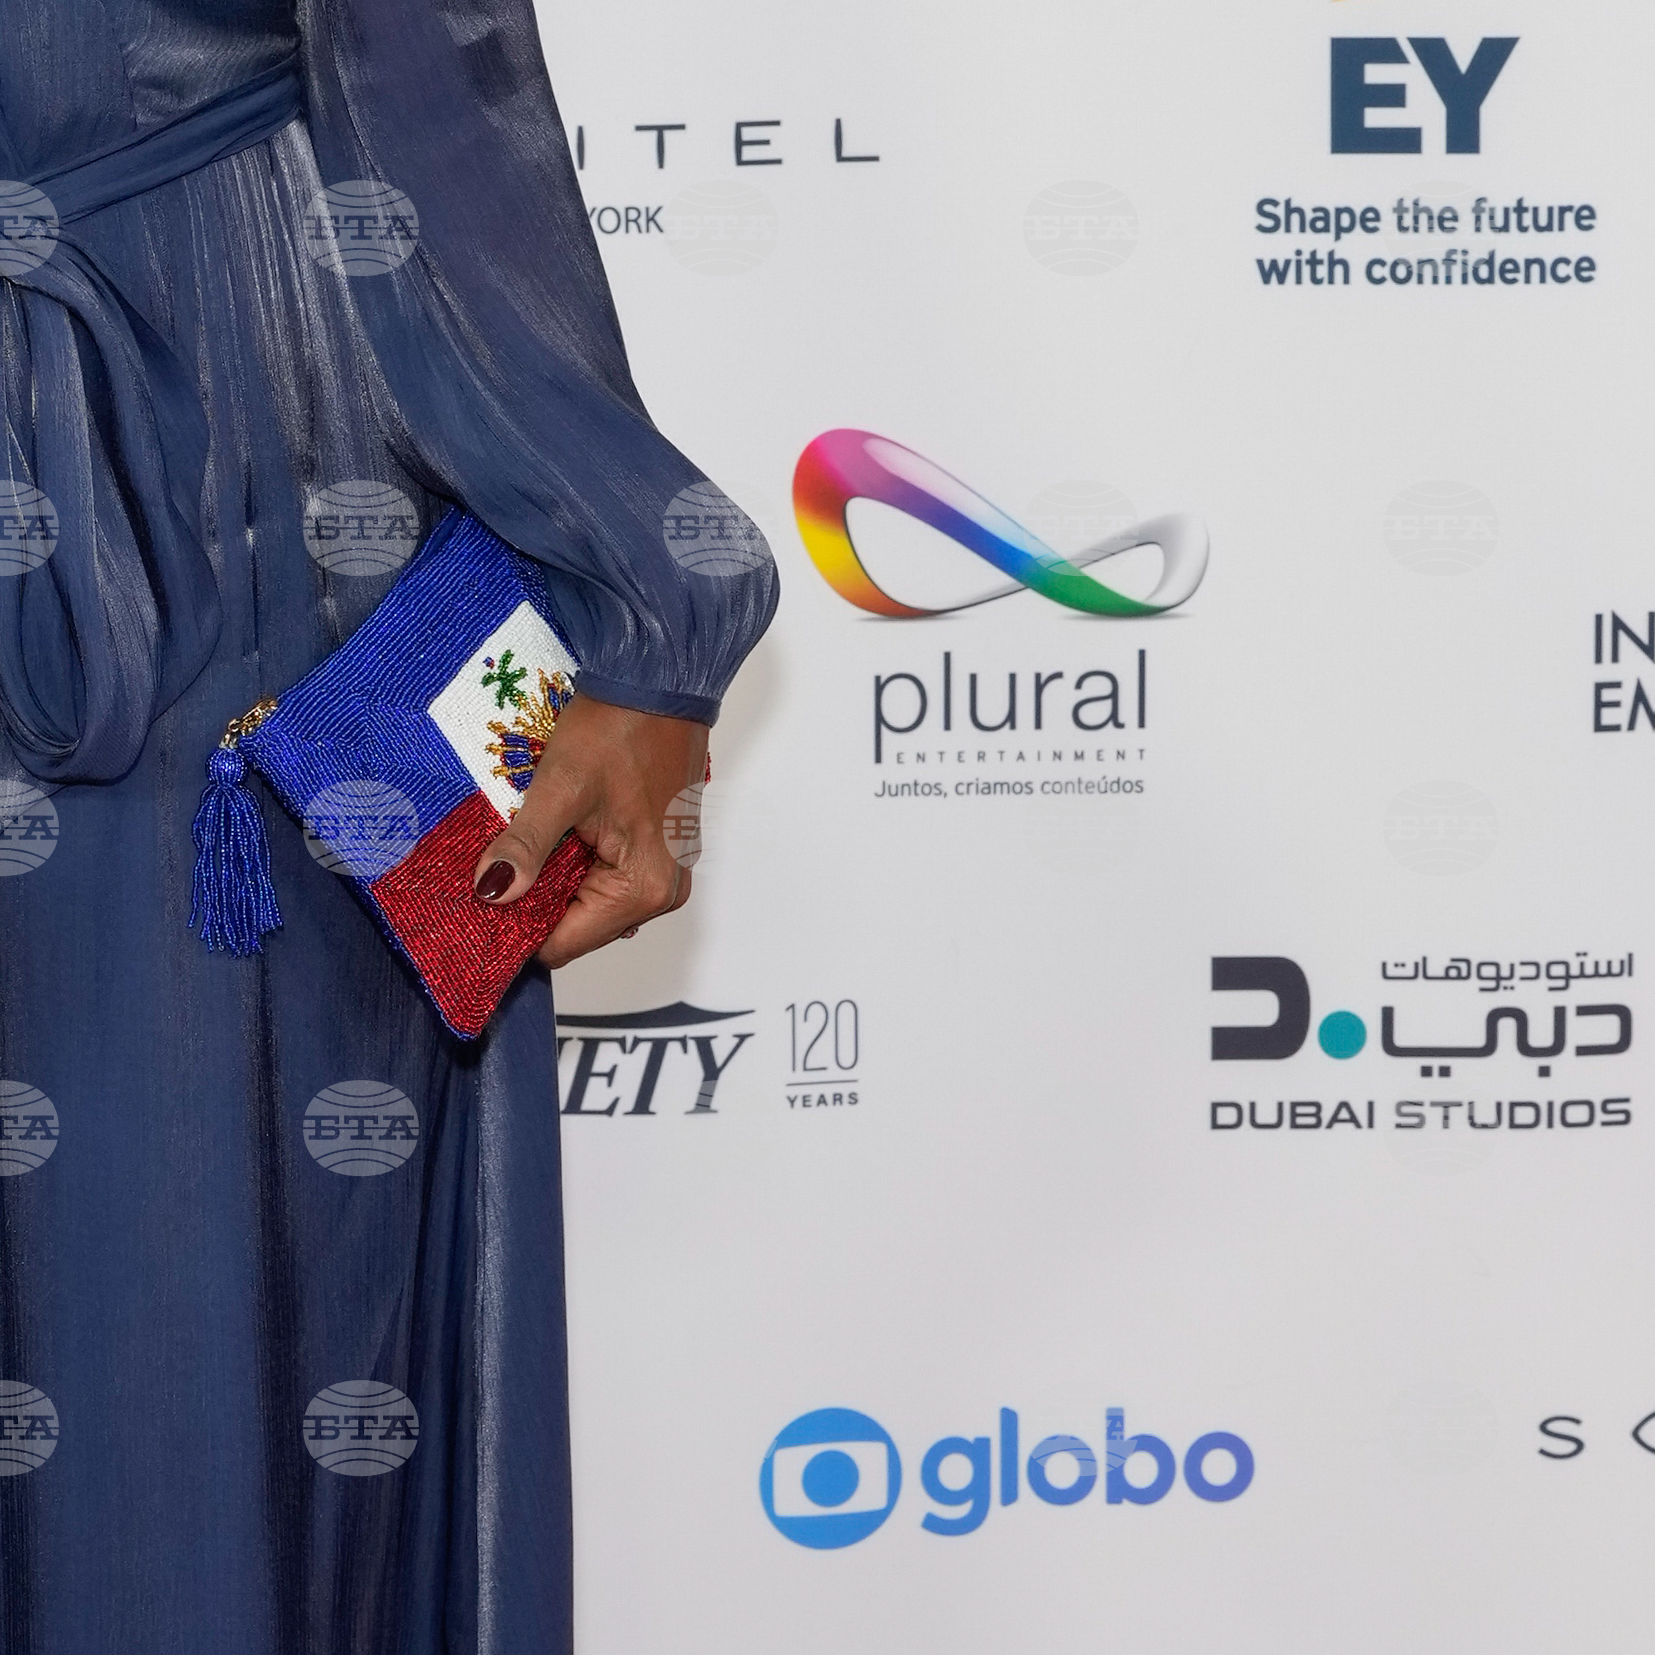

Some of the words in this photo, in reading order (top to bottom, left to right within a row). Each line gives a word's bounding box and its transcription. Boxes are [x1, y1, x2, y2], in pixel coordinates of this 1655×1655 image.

[1329, 36, 1521, 155] EY
[576, 118, 881, 171] ITEL
[1255, 197, 1382, 243] Shape
[1392, 197, 1460, 234] the
[1471, 196, 1597, 234] future
[1255, 248, 1351, 286] with
[1364, 248, 1597, 286] confidence
[873, 648, 1147, 765] plural
[896, 748, 1145, 765] ENTERTAINMENT
[873, 779, 948, 799] Juntos,
[954, 777, 1034, 796] criamos
[1040, 775, 1145, 795] conteúdos
[556, 1033, 755, 1117] ETY
[785, 999, 859, 1072] 120
[786, 1091, 859, 1109] YEARS
[1209, 1100, 1375, 1131] DUBAI
[1394, 1096, 1632, 1130] STUDIOS
[919, 1406, 1255, 1538] globo
